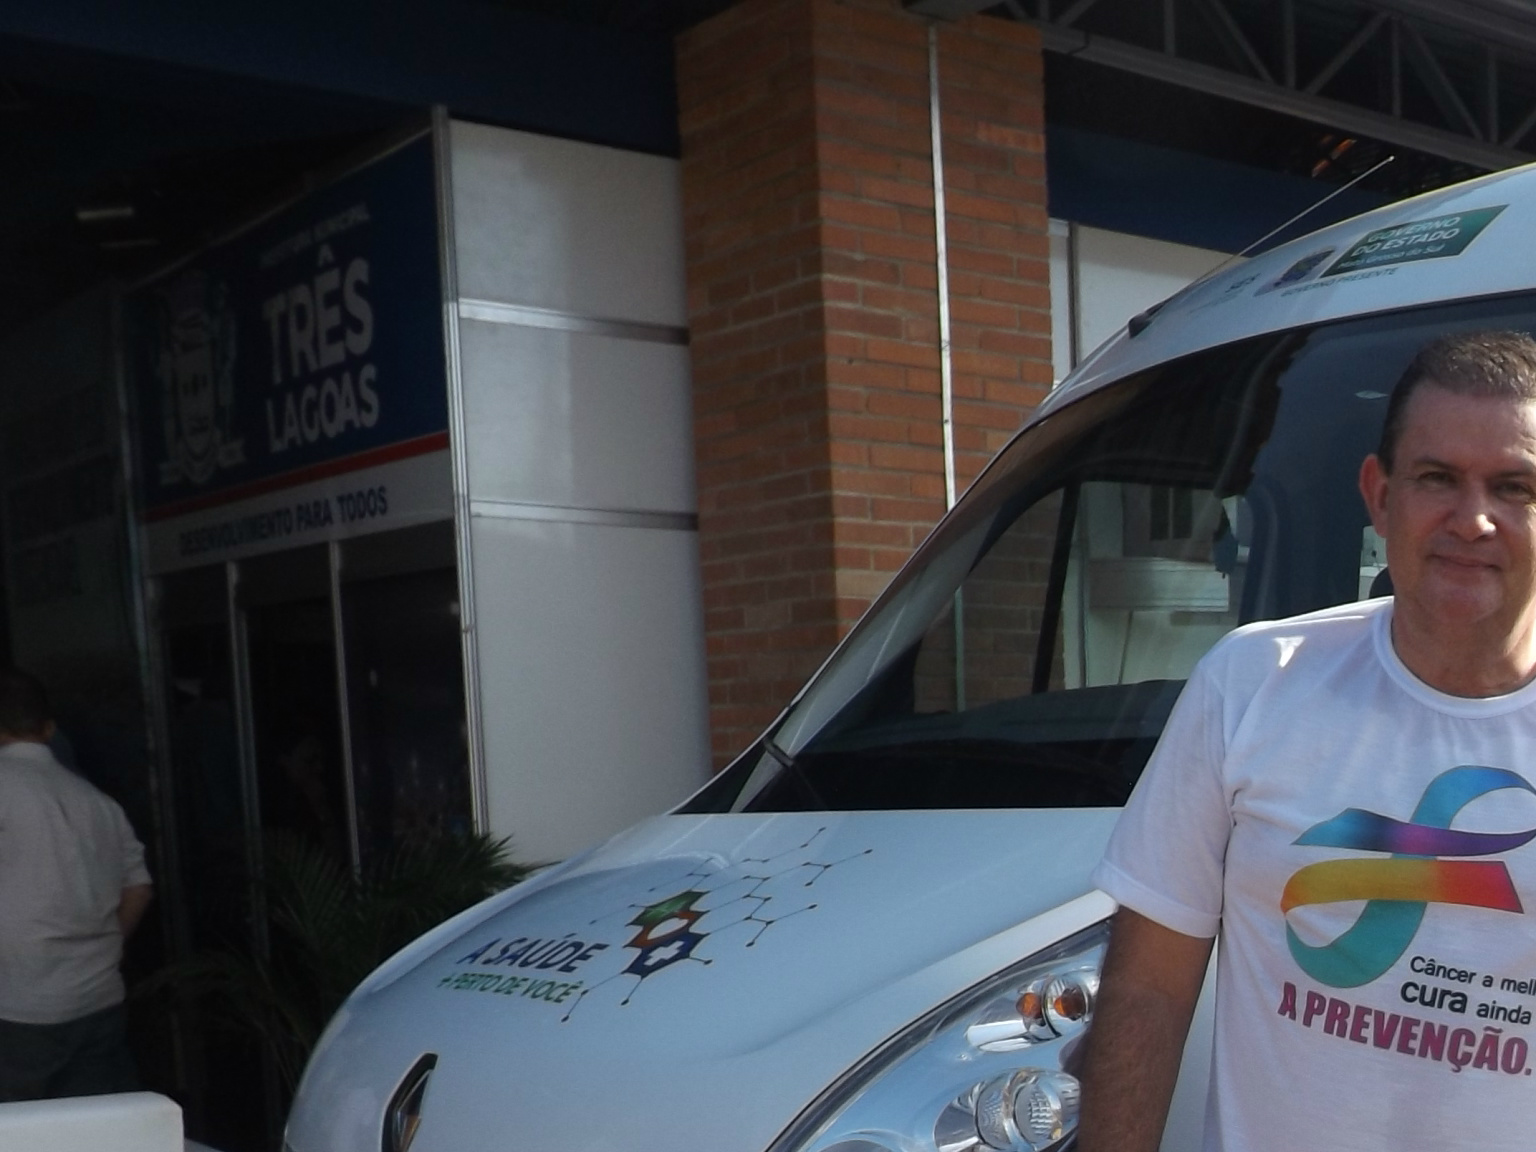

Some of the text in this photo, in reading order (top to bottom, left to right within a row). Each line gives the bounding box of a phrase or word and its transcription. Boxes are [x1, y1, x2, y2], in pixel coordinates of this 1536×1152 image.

[1350, 228, 1460, 258] DO ESTADO
[1367, 216, 1461, 244] GOVERNO
[262, 242, 375, 385] TRÊS
[265, 363, 380, 453] LAGOAS
[179, 486, 388, 556] DESENVOLVIMENTO PARA TODOS
[456, 932, 611, 973] A SAÚDE
[1409, 955, 1478, 985] Câncer
[1482, 974, 1494, 989] a
[493, 976, 531, 995] DE
[520, 979, 584, 1004] VOCÊ
[1400, 981, 1468, 1014] cura
[1476, 1000, 1532, 1026] ainda
[1277, 981, 1532, 1076] A PREVENÇÃO.
